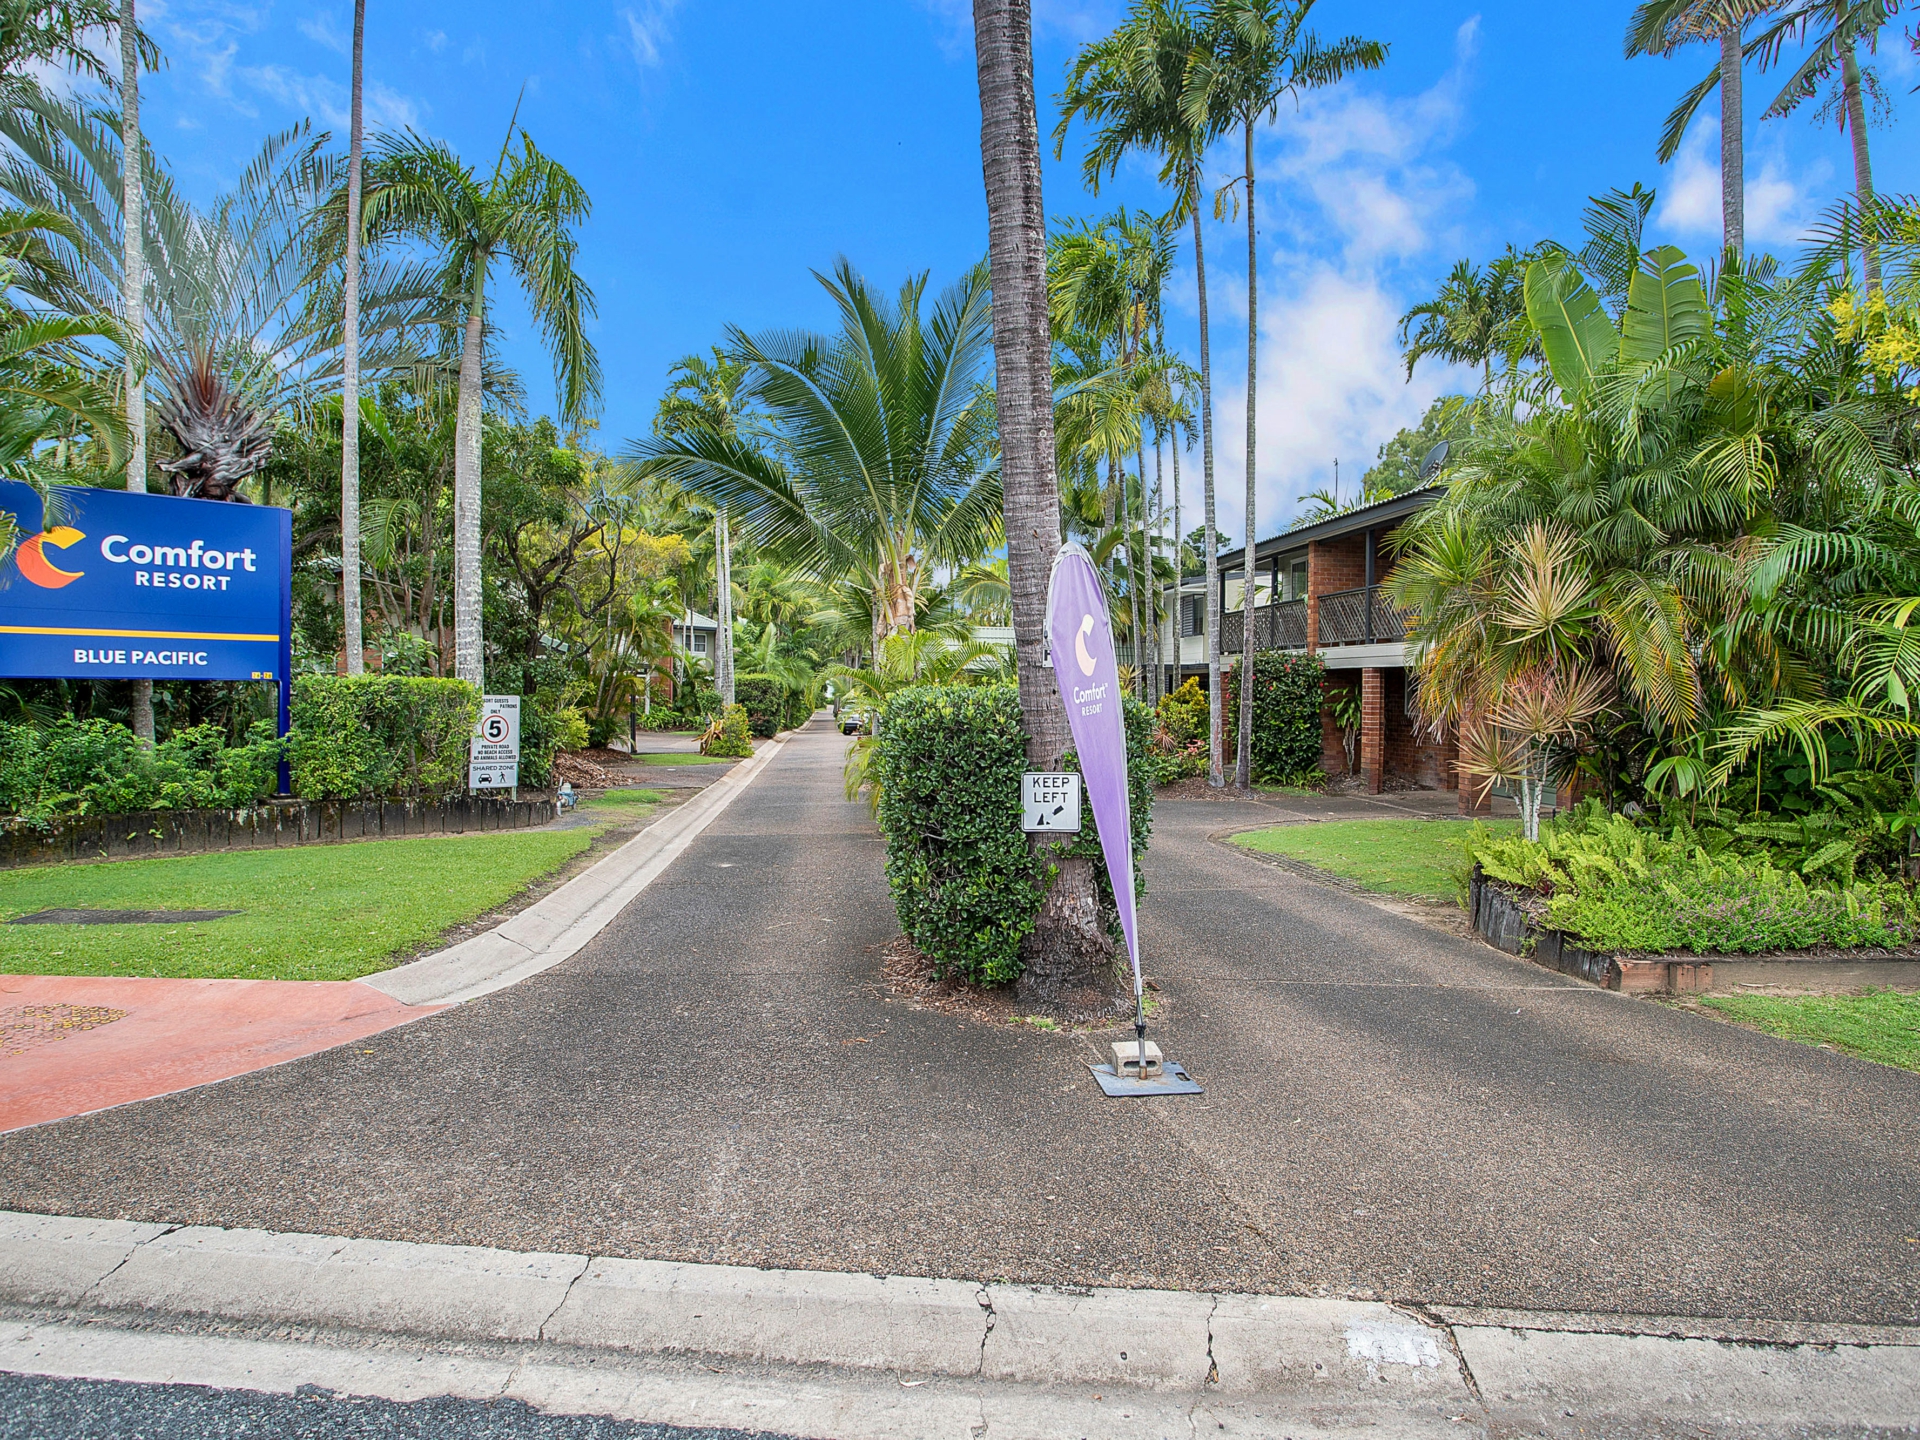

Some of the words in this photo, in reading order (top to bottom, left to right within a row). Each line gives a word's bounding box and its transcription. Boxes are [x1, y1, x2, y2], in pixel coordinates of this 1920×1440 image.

[100, 535, 256, 572] Comfort
[135, 571, 230, 590] RESORT
[74, 650, 126, 664] BLUE
[132, 651, 208, 665] PACIFIC
[1074, 682, 1106, 704] Comfort
[1082, 703, 1102, 716] RESORT
[488, 720, 502, 738] 5
[1032, 777, 1070, 788] KEEP
[1034, 792, 1068, 803] LEFT
